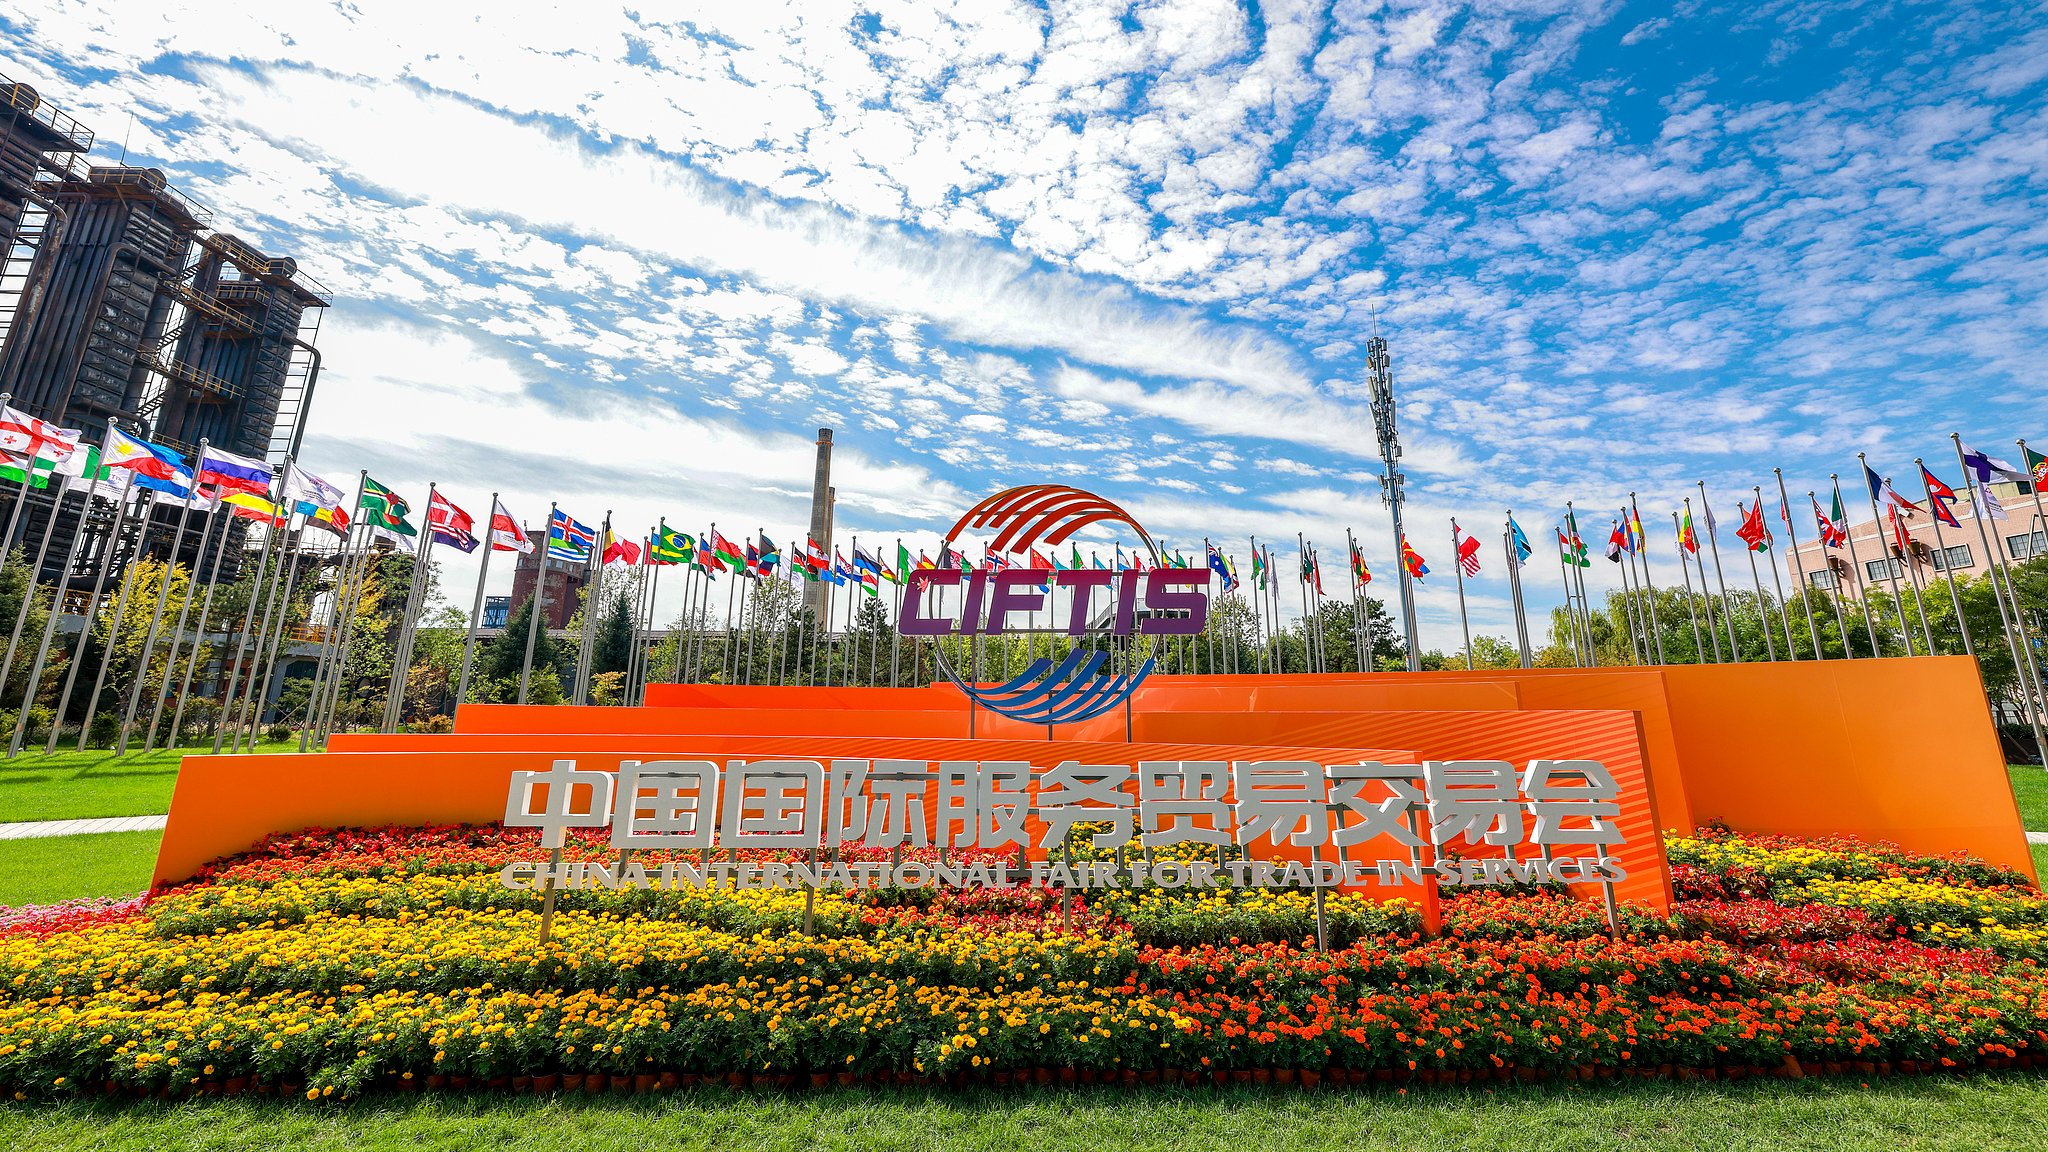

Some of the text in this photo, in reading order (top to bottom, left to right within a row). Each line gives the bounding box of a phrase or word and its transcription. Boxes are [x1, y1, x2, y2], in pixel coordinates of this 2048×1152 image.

[900, 569, 1211, 635] CIFTIS
[504, 759, 1628, 849] 中国国际服务贸易交易会
[500, 856, 1627, 889] CHINA INTERNATIONAL FAIR FOR TRADE IN SERVICES
